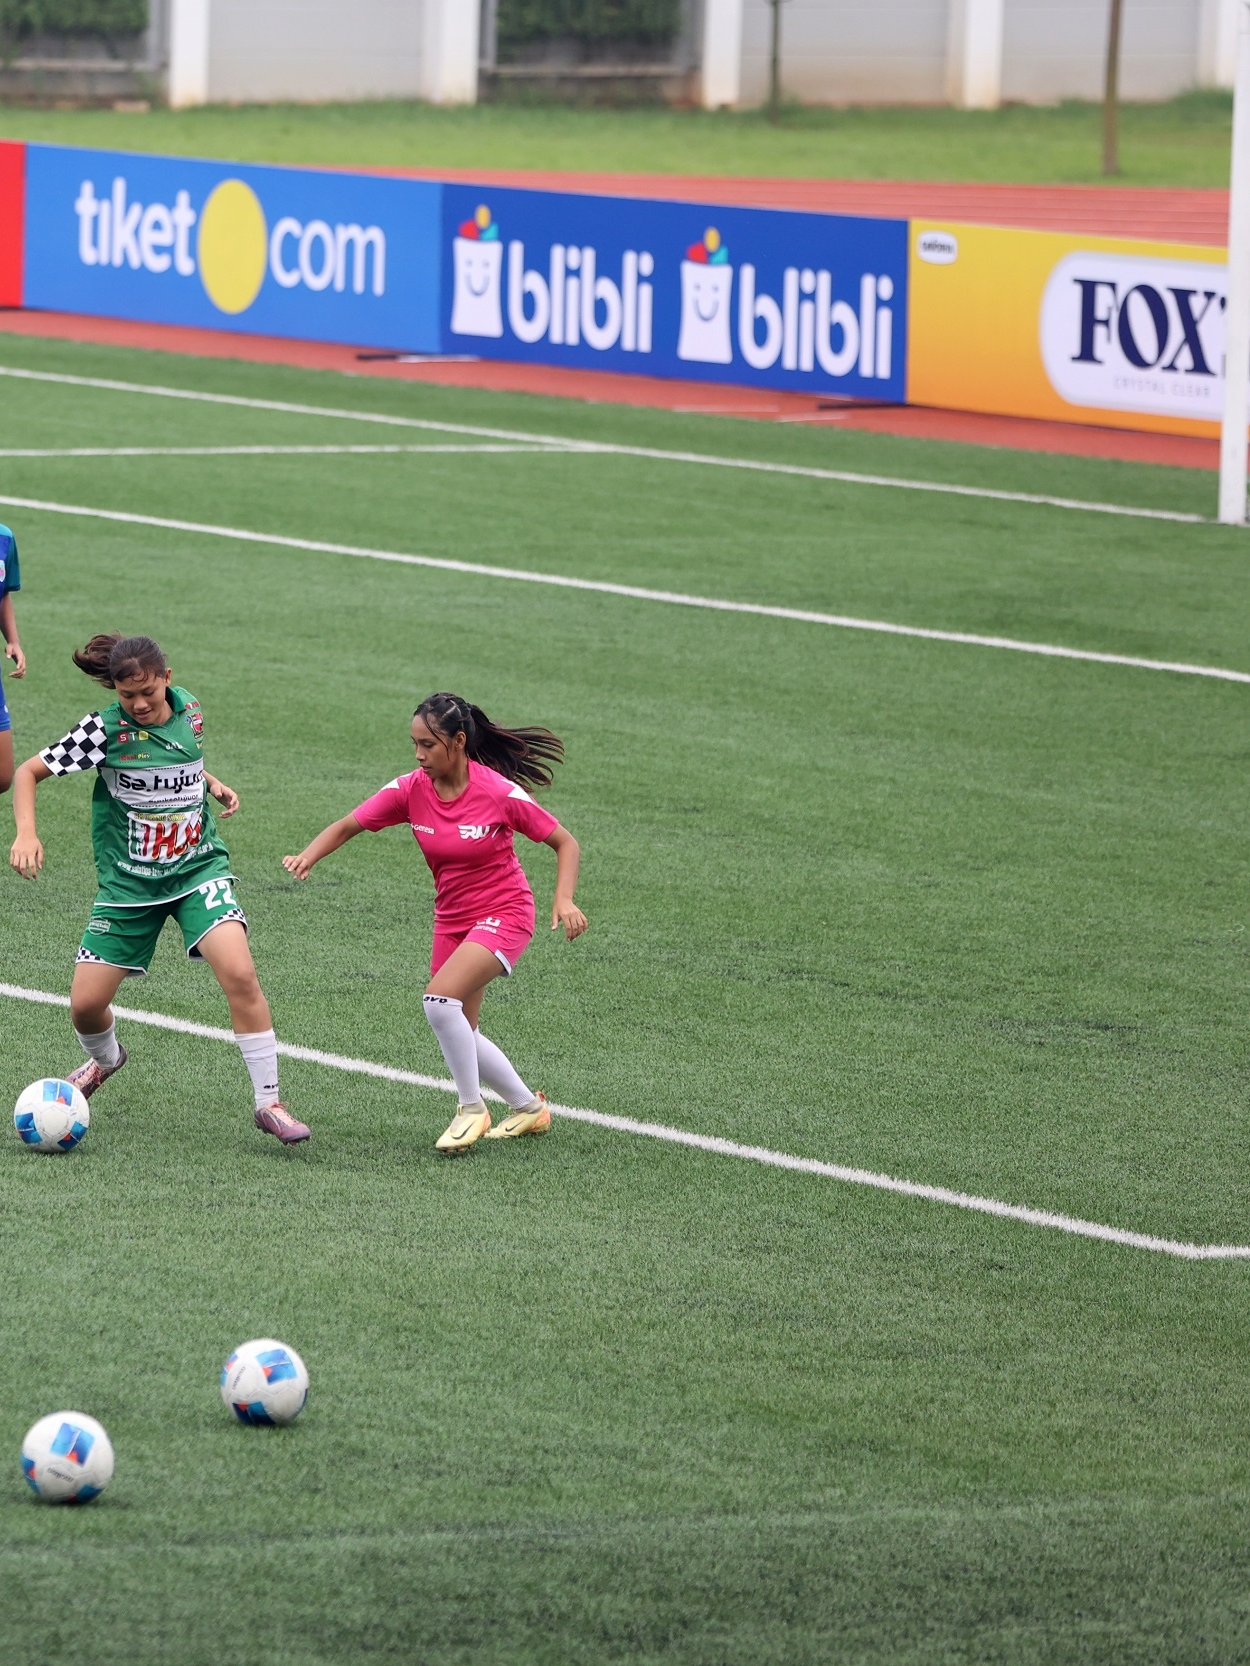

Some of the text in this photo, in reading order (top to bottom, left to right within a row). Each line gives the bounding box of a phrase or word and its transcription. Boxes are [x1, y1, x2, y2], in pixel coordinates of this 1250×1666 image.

[507, 240, 894, 380] blibli blibli
[1070, 277, 1228, 377] FOX'
[199, 879, 238, 911] 22
